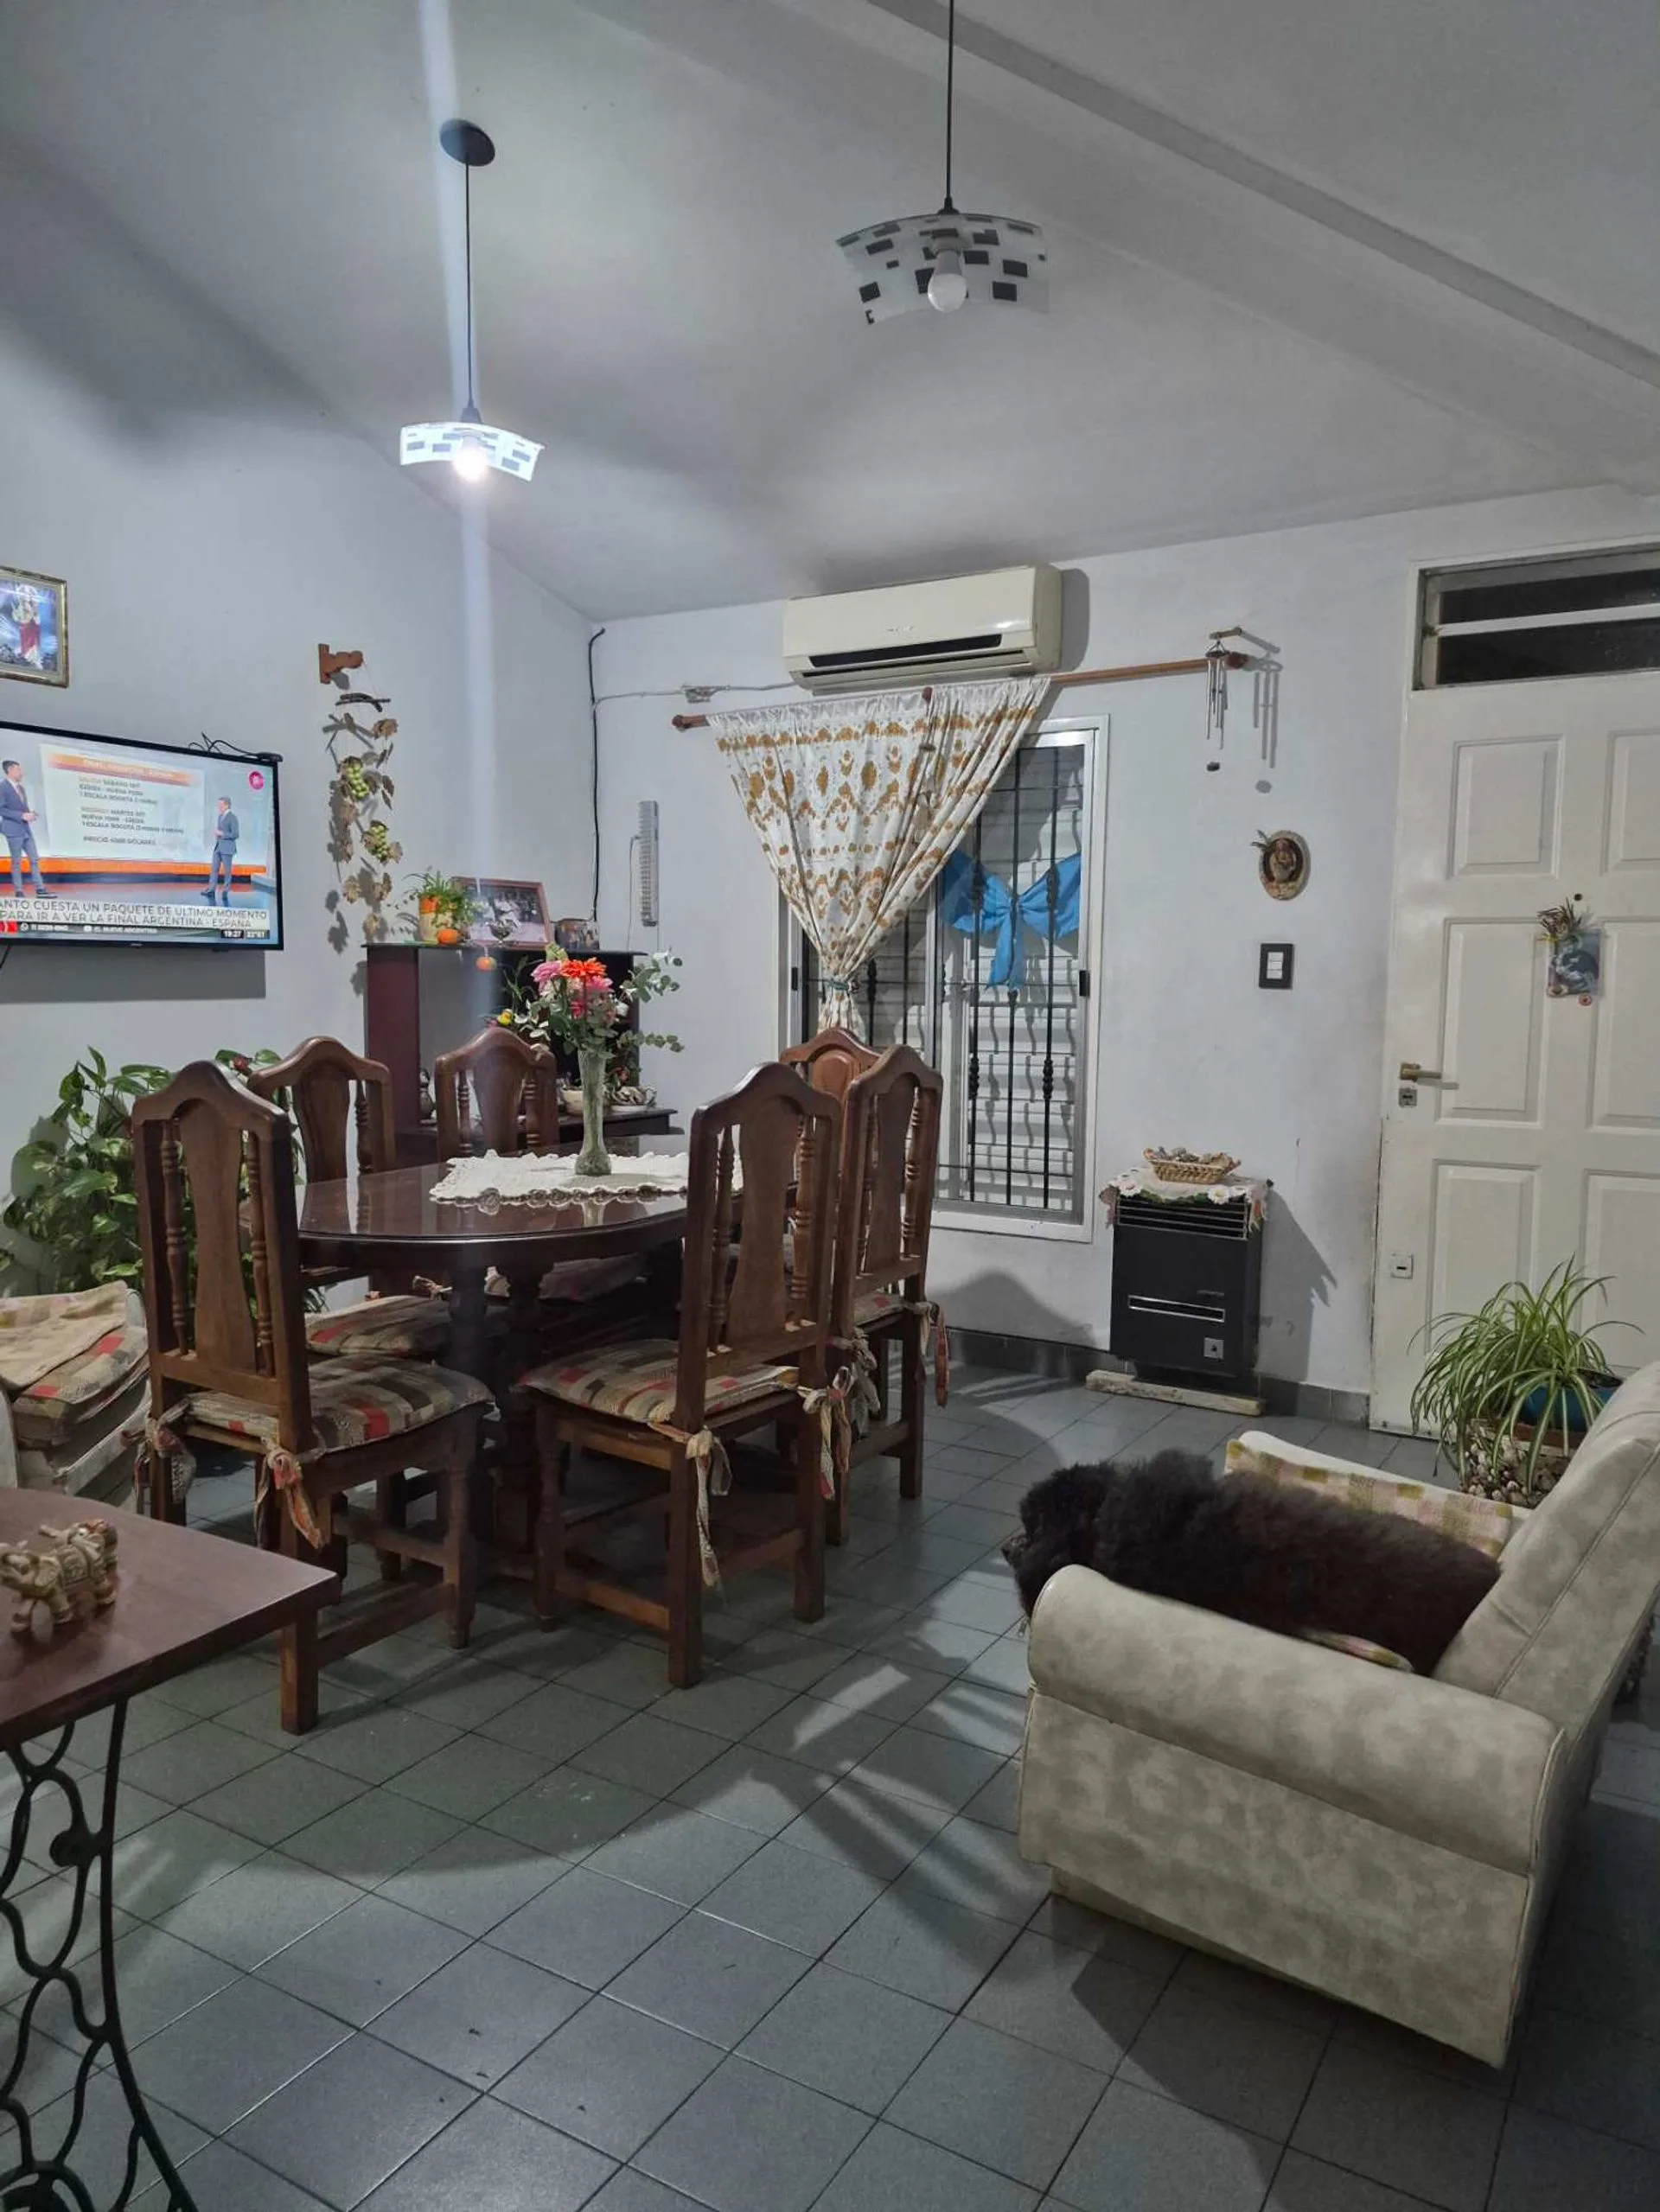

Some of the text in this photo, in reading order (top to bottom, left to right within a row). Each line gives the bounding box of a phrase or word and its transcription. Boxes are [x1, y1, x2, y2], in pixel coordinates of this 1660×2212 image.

[0, 909, 33, 920] PARA
[36, 911, 48, 921] IR
[52, 912, 61, 921] A
[64, 912, 86, 922] VER
[90, 914, 105, 923] LA
[109, 914, 139, 924] FINAL
[142, 915, 204, 926] ARGENTINA
[33, 900, 80, 911] CUESTA
[83, 902, 100, 912] UN
[103, 902, 155, 915] PAQUETE
[158, 904, 171, 915] DE
[216, 908, 267, 920] MOMENTO
